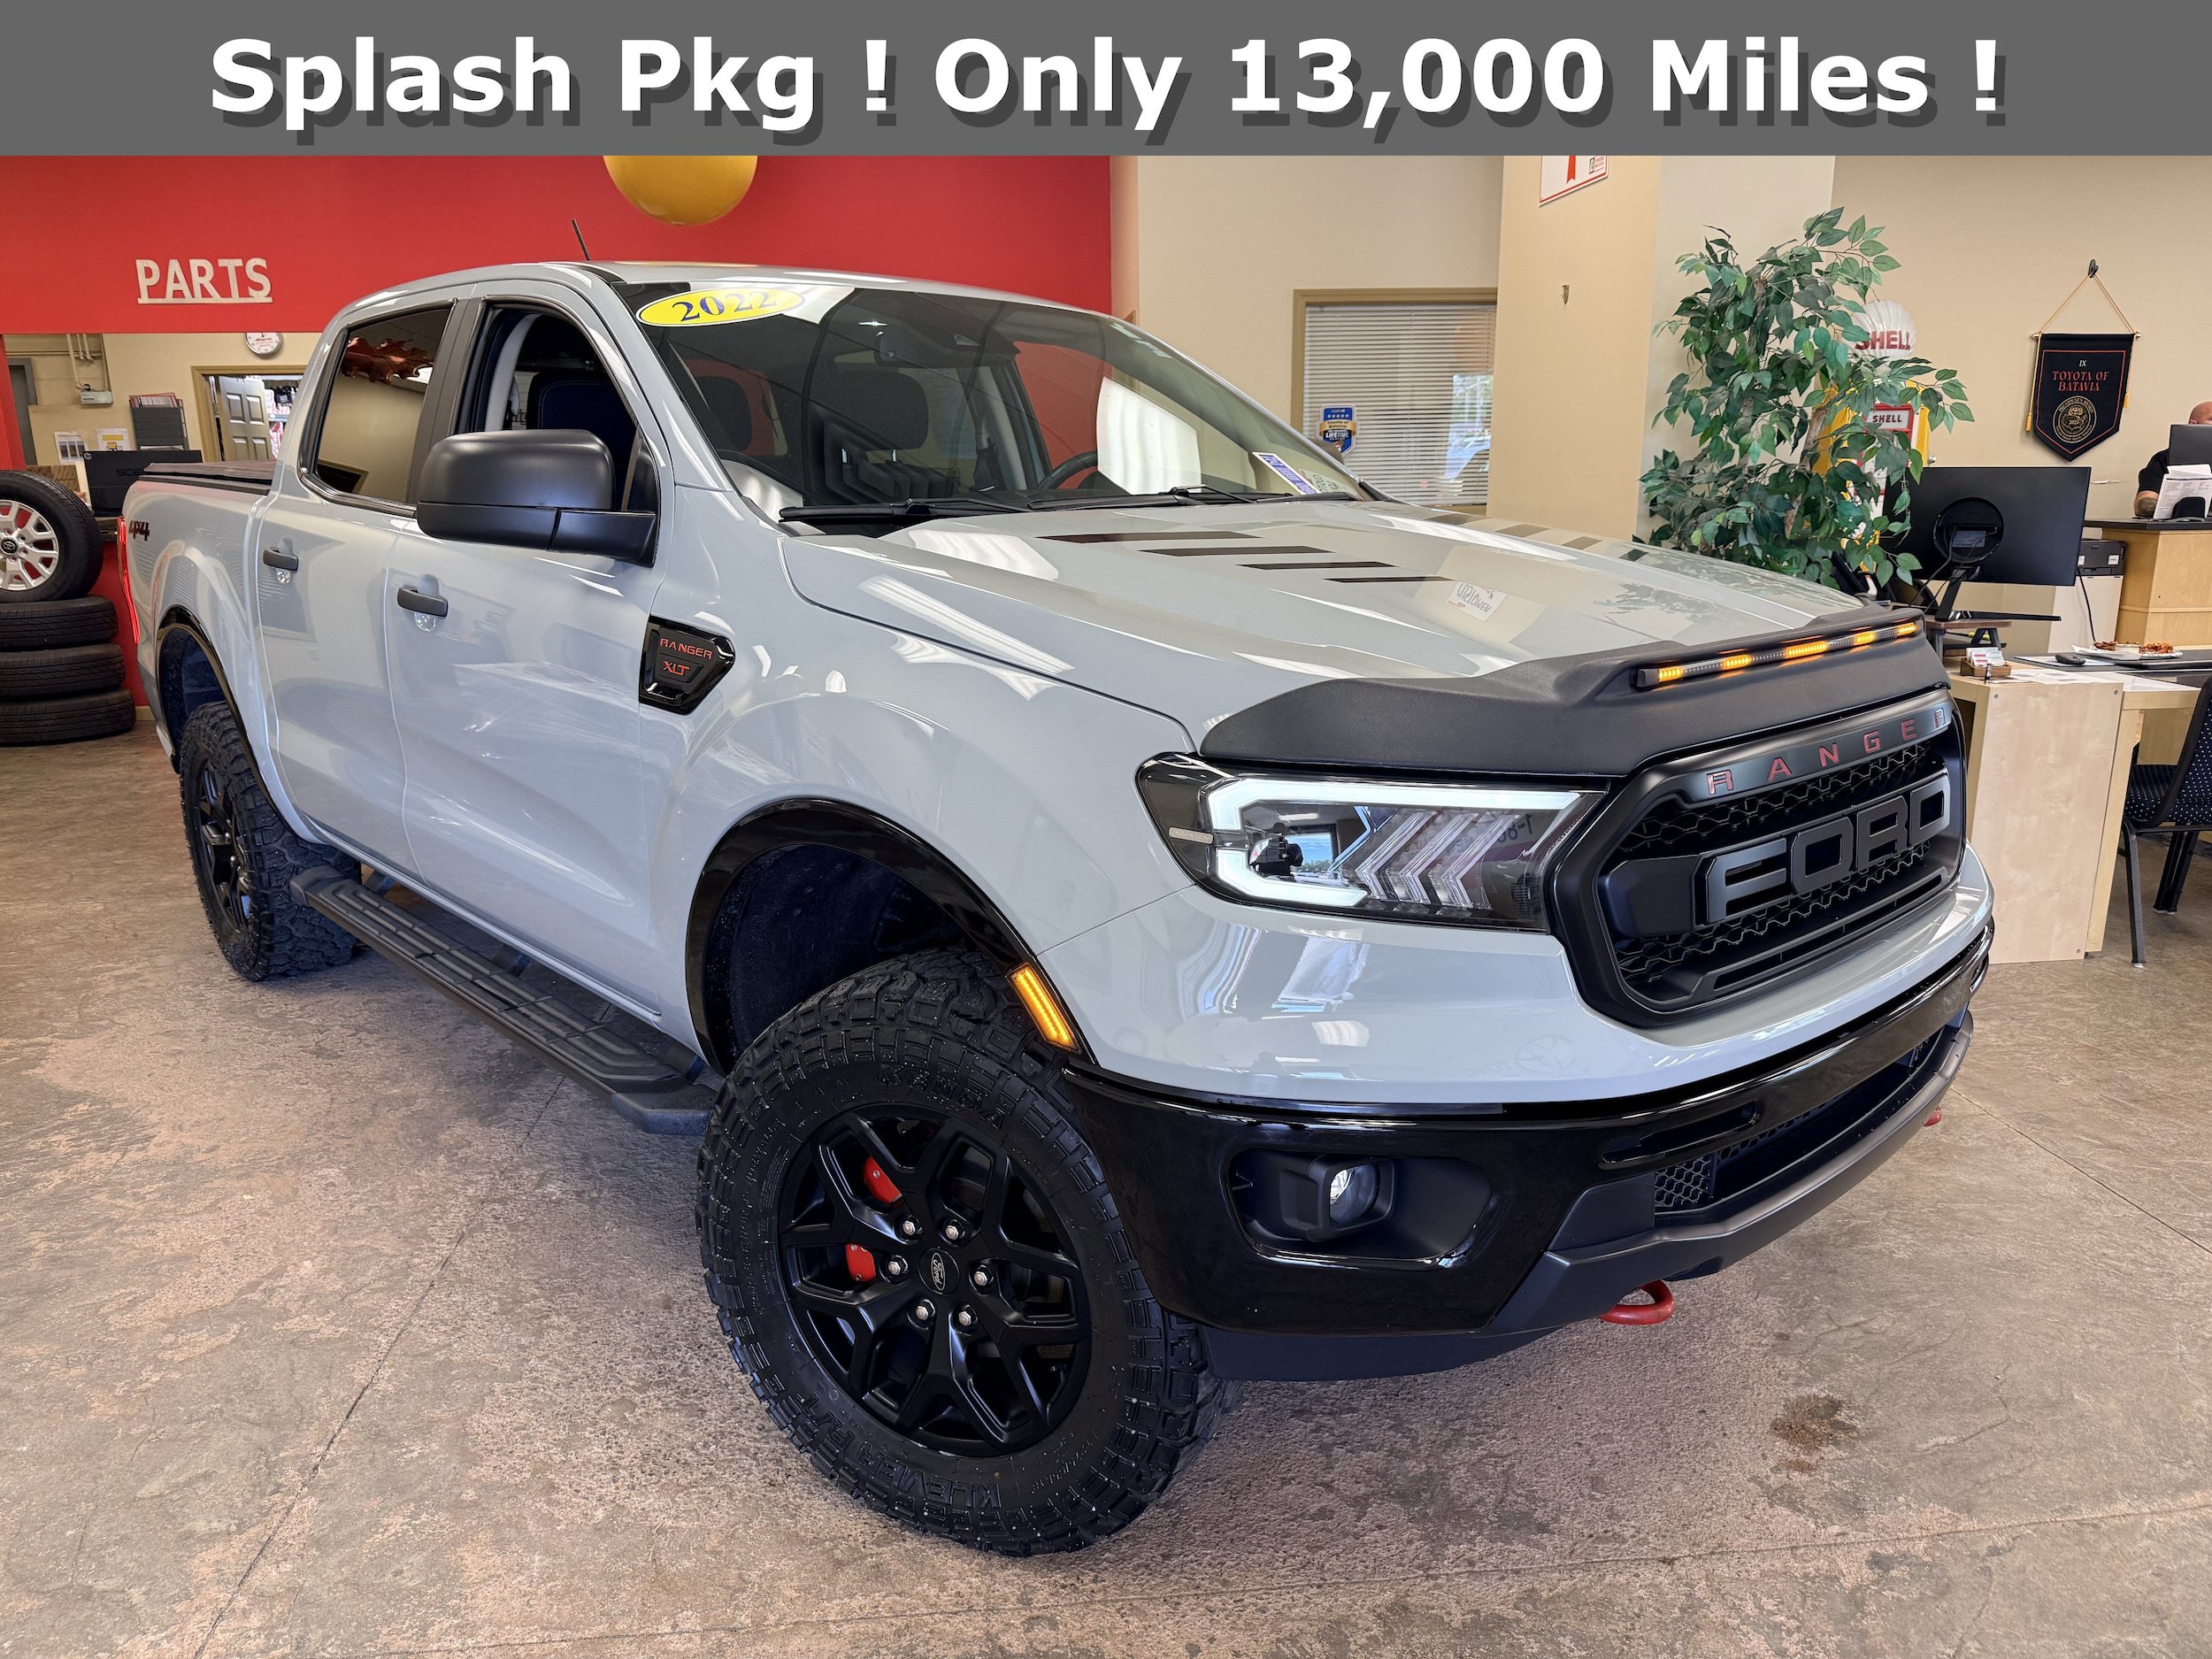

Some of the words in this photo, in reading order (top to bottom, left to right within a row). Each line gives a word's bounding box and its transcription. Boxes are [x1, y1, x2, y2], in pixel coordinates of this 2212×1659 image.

[135, 257, 272, 303] PARTS
[672, 290, 777, 322] 2022
[2053, 371, 2092, 381] TOYOTA
[2095, 371, 2110, 381] OF
[2058, 381, 2100, 391] BATAVIA
[1872, 414, 1902, 423] SHELL
[659, 638, 712, 660] RANGER
[663, 660, 690, 676] XLT
[1706, 707, 1946, 795] RANGER
[1703, 773, 1951, 926] FORD
[856, 1440, 1002, 1509] KLEVER
